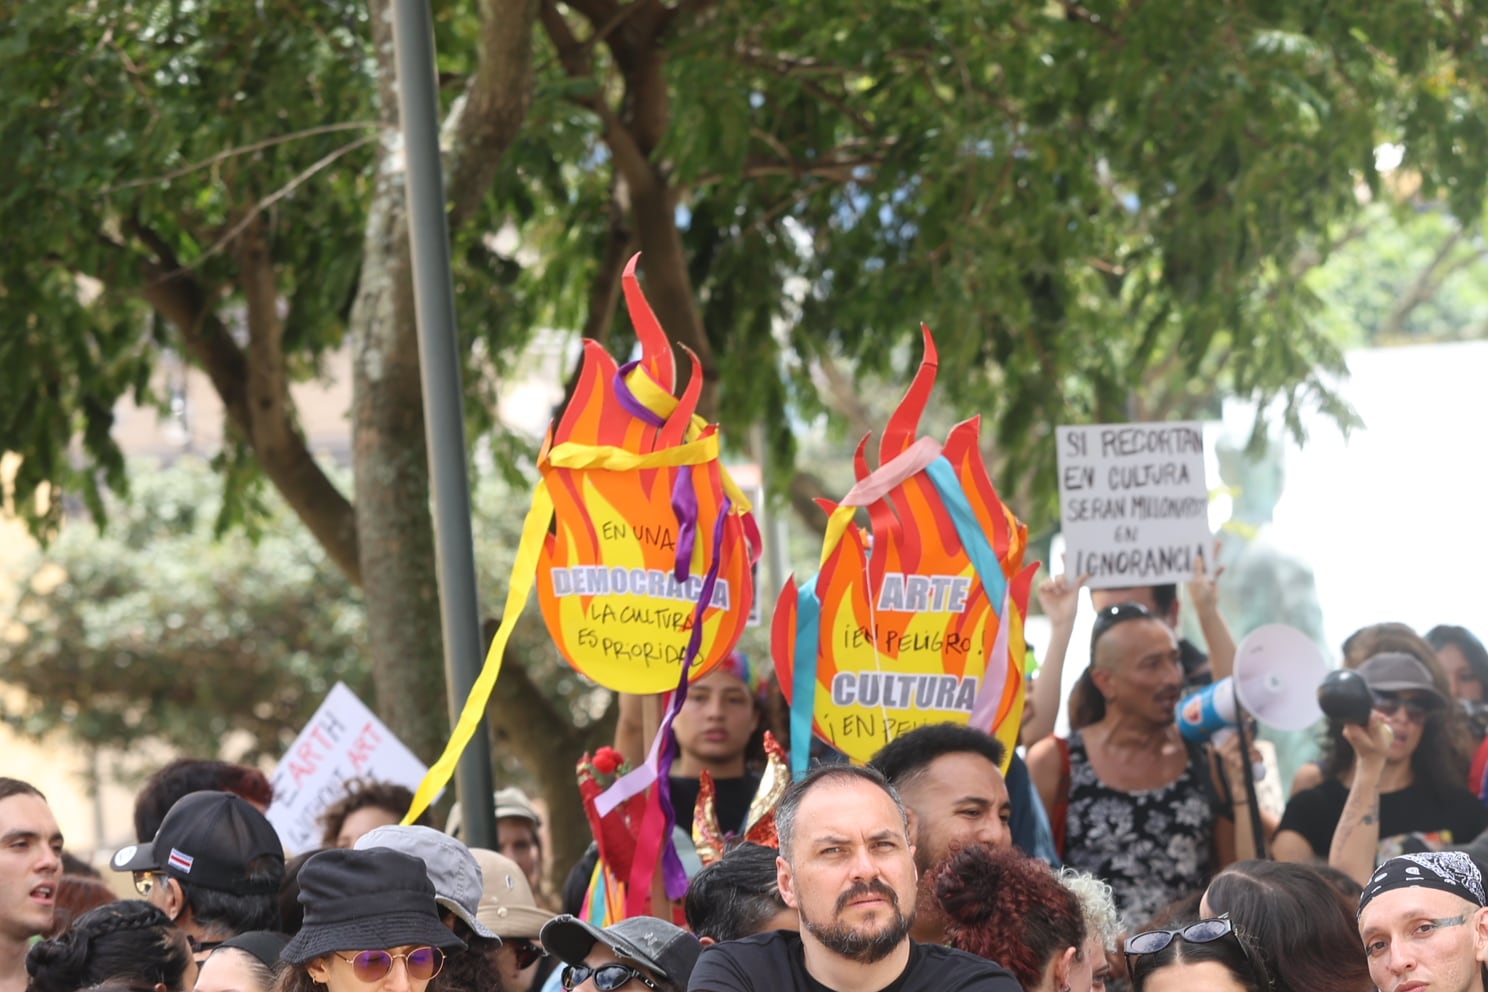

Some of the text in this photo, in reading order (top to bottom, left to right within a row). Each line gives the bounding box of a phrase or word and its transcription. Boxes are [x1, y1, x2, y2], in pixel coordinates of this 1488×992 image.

[1066, 427, 1203, 459] SI RECORTAN
[1064, 462, 1191, 492] EN CULTURA
[602, 520, 676, 551] EN UNA
[551, 566, 731, 611] DEMOCRACA
[876, 572, 972, 613] ARTE
[592, 603, 695, 633] LA CULTURA
[577, 627, 599, 648] ES
[832, 671, 979, 713] CULTURA
